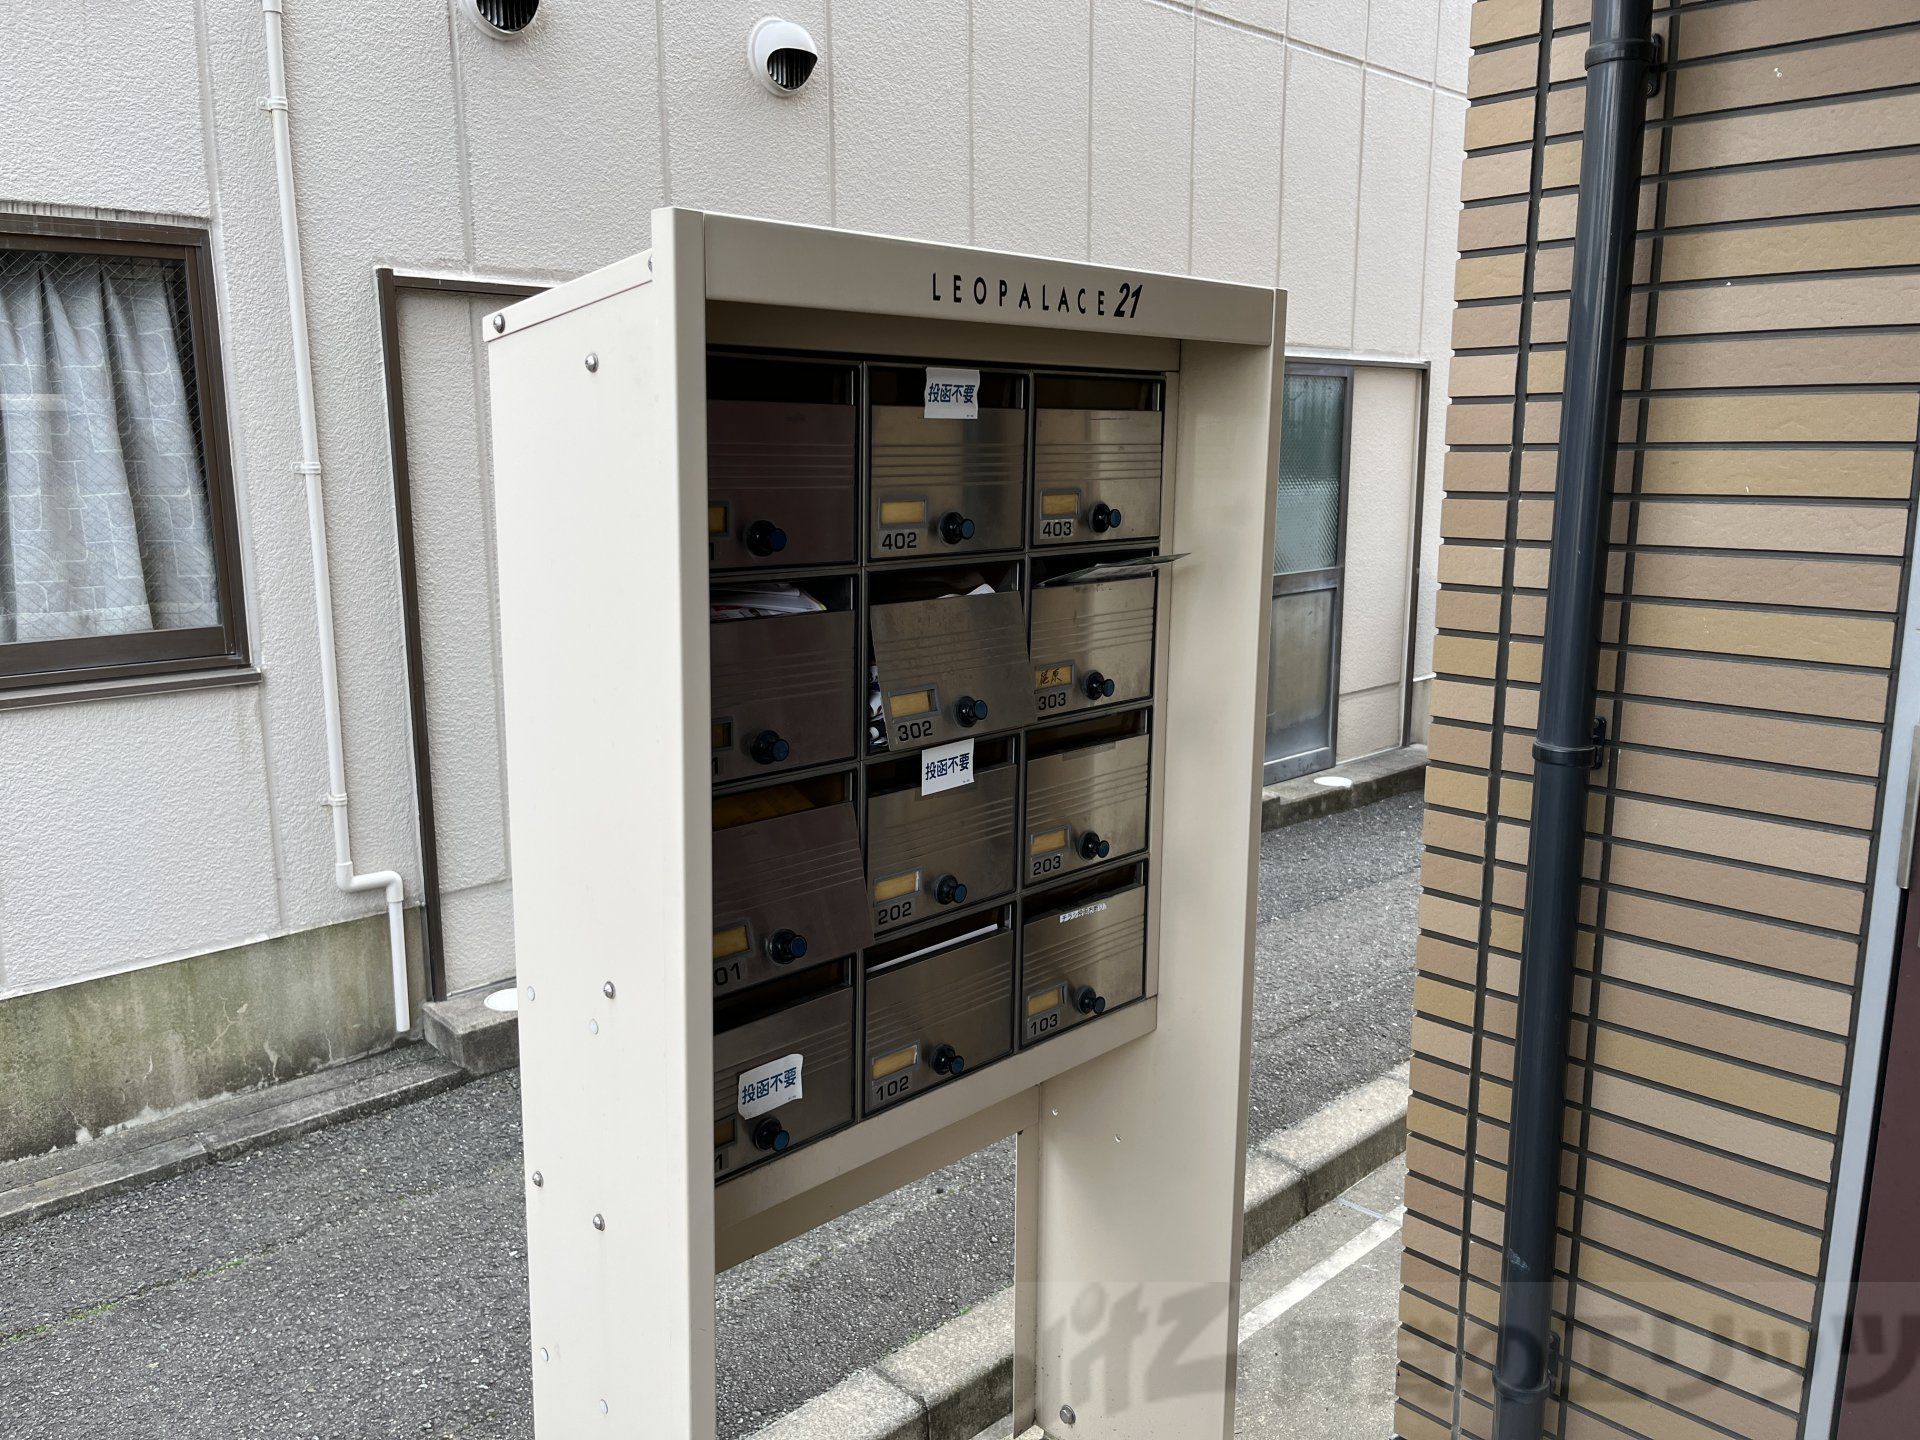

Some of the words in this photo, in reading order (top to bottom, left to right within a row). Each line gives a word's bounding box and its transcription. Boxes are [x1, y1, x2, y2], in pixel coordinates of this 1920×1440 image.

[927, 382, 976, 404] 投函不要
[1042, 519, 1073, 537] 403
[881, 531, 918, 550] 402
[1038, 692, 1066, 710] 303
[897, 721, 933, 742] 302
[925, 752, 970, 780] 投函不要
[1032, 856, 1062, 876] 203
[877, 902, 912, 925] 202
[714, 962, 742, 985] 01
[1030, 1014, 1058, 1035] 103
[742, 1066, 797, 1105] 投函不要
[875, 1076, 910, 1101] 102
